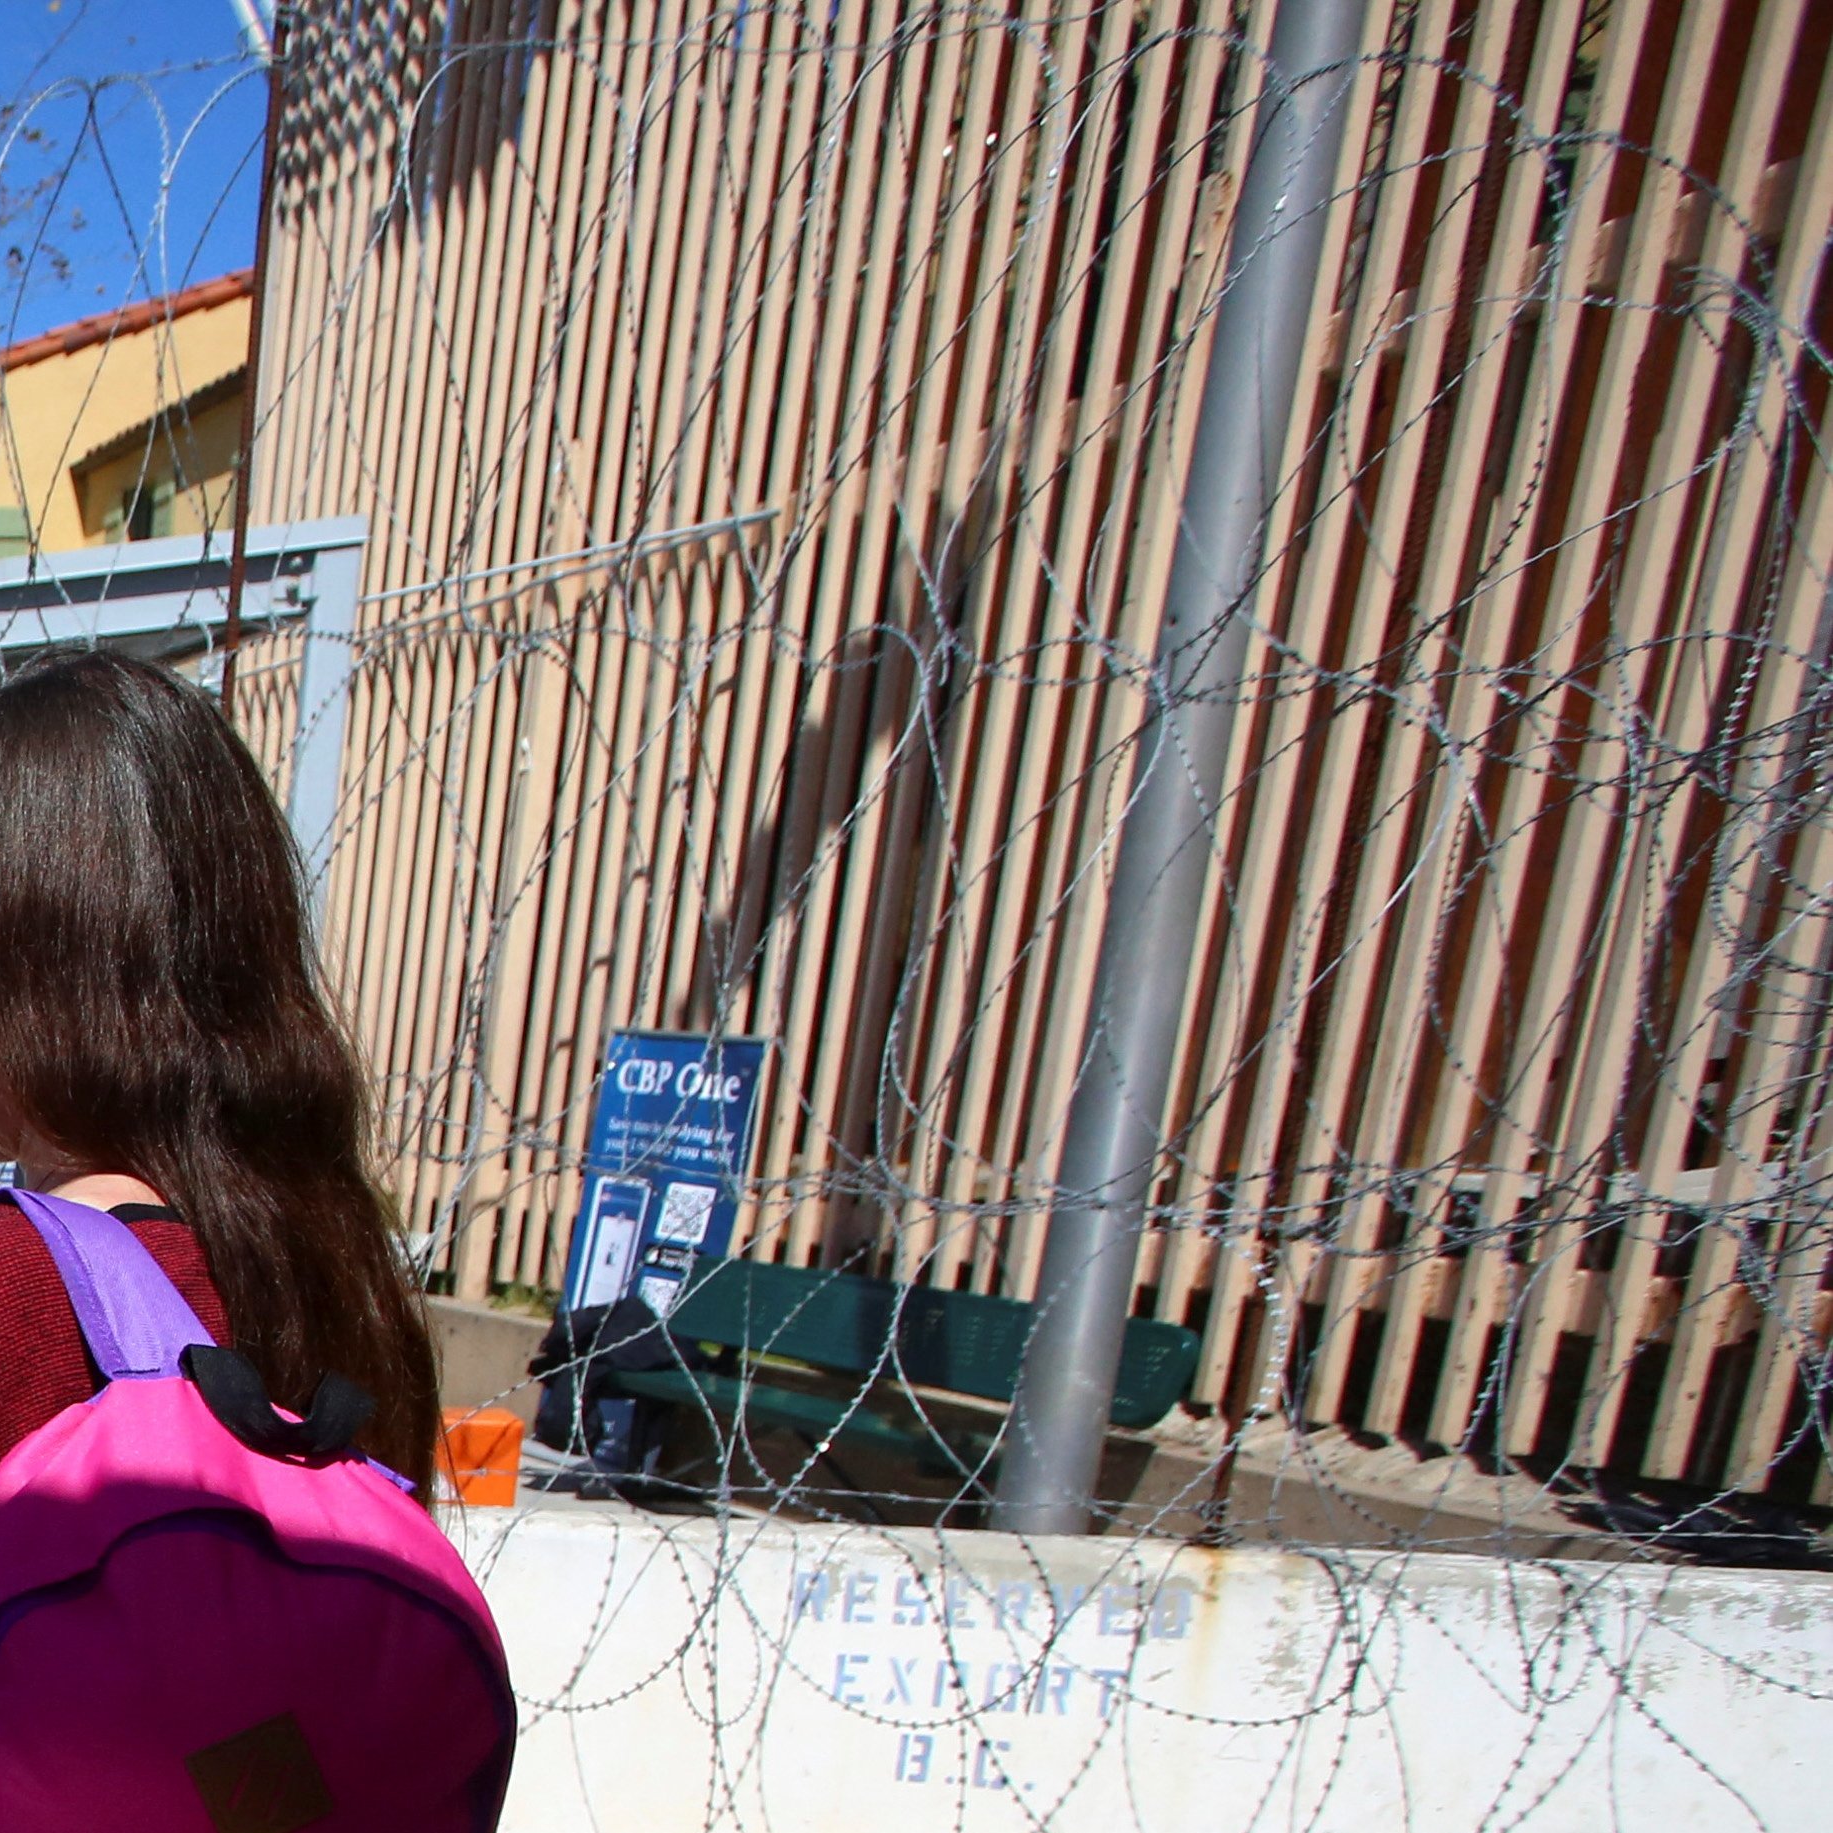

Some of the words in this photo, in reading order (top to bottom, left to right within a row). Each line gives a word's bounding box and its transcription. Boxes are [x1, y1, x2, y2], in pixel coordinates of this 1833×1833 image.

[616, 1059, 673, 1096] CBP
[675, 1061, 742, 1102] One
[792, 1571, 1192, 1640] RESERVED
[833, 1653, 1130, 1719] EXPORT
